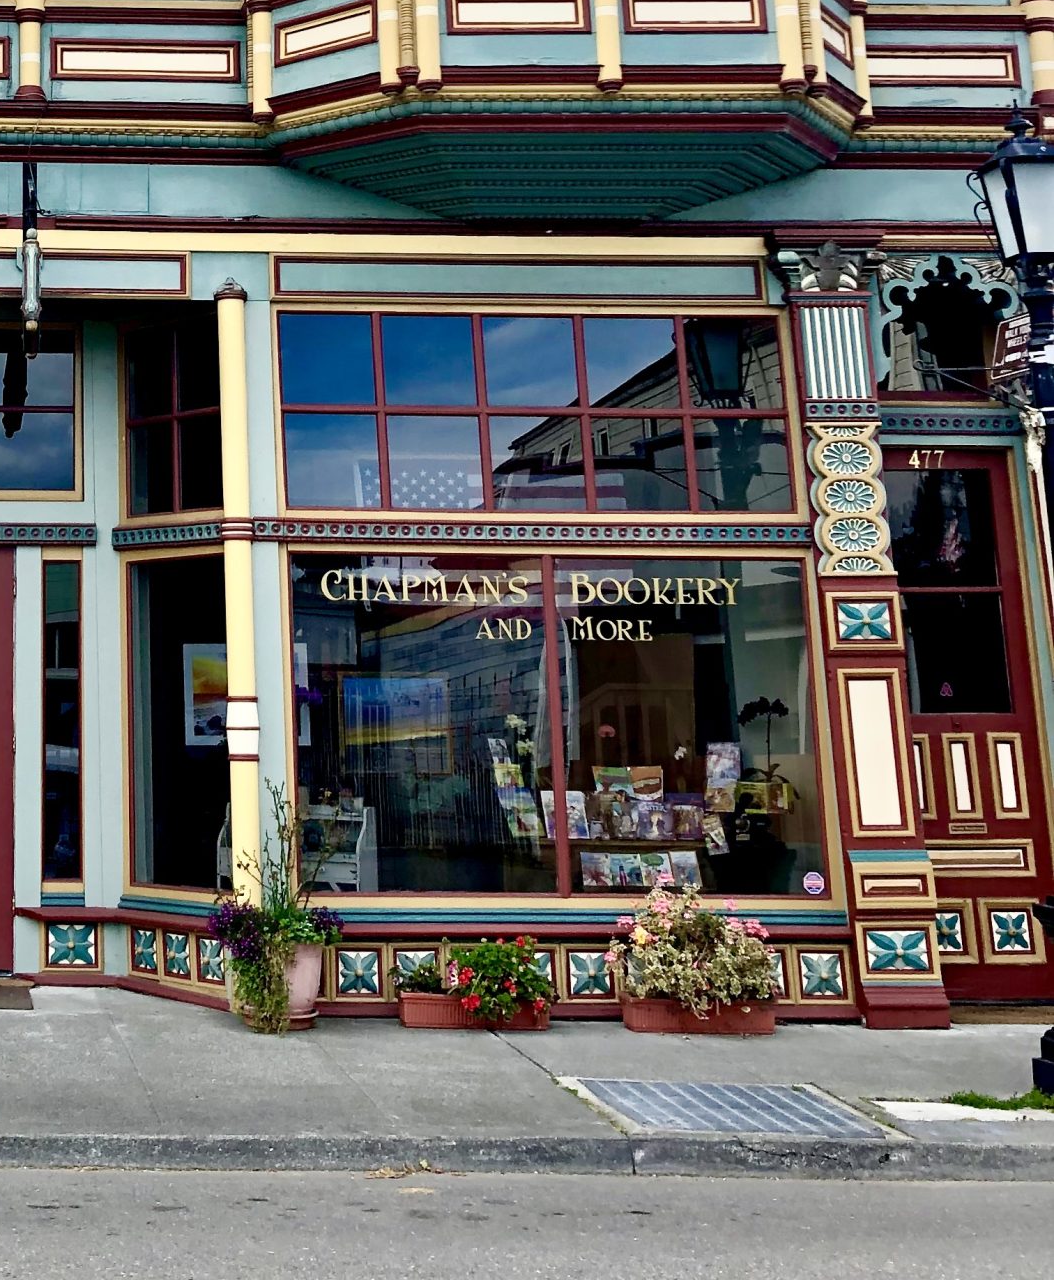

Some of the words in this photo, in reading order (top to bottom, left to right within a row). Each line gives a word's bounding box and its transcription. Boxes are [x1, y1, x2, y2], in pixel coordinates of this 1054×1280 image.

[908, 449, 945, 469] 477
[320, 568, 530, 605] CHAPMAN'S
[569, 571, 742, 605] BOOKERY
[475, 617, 532, 642] AND
[570, 616, 653, 641] MORE
